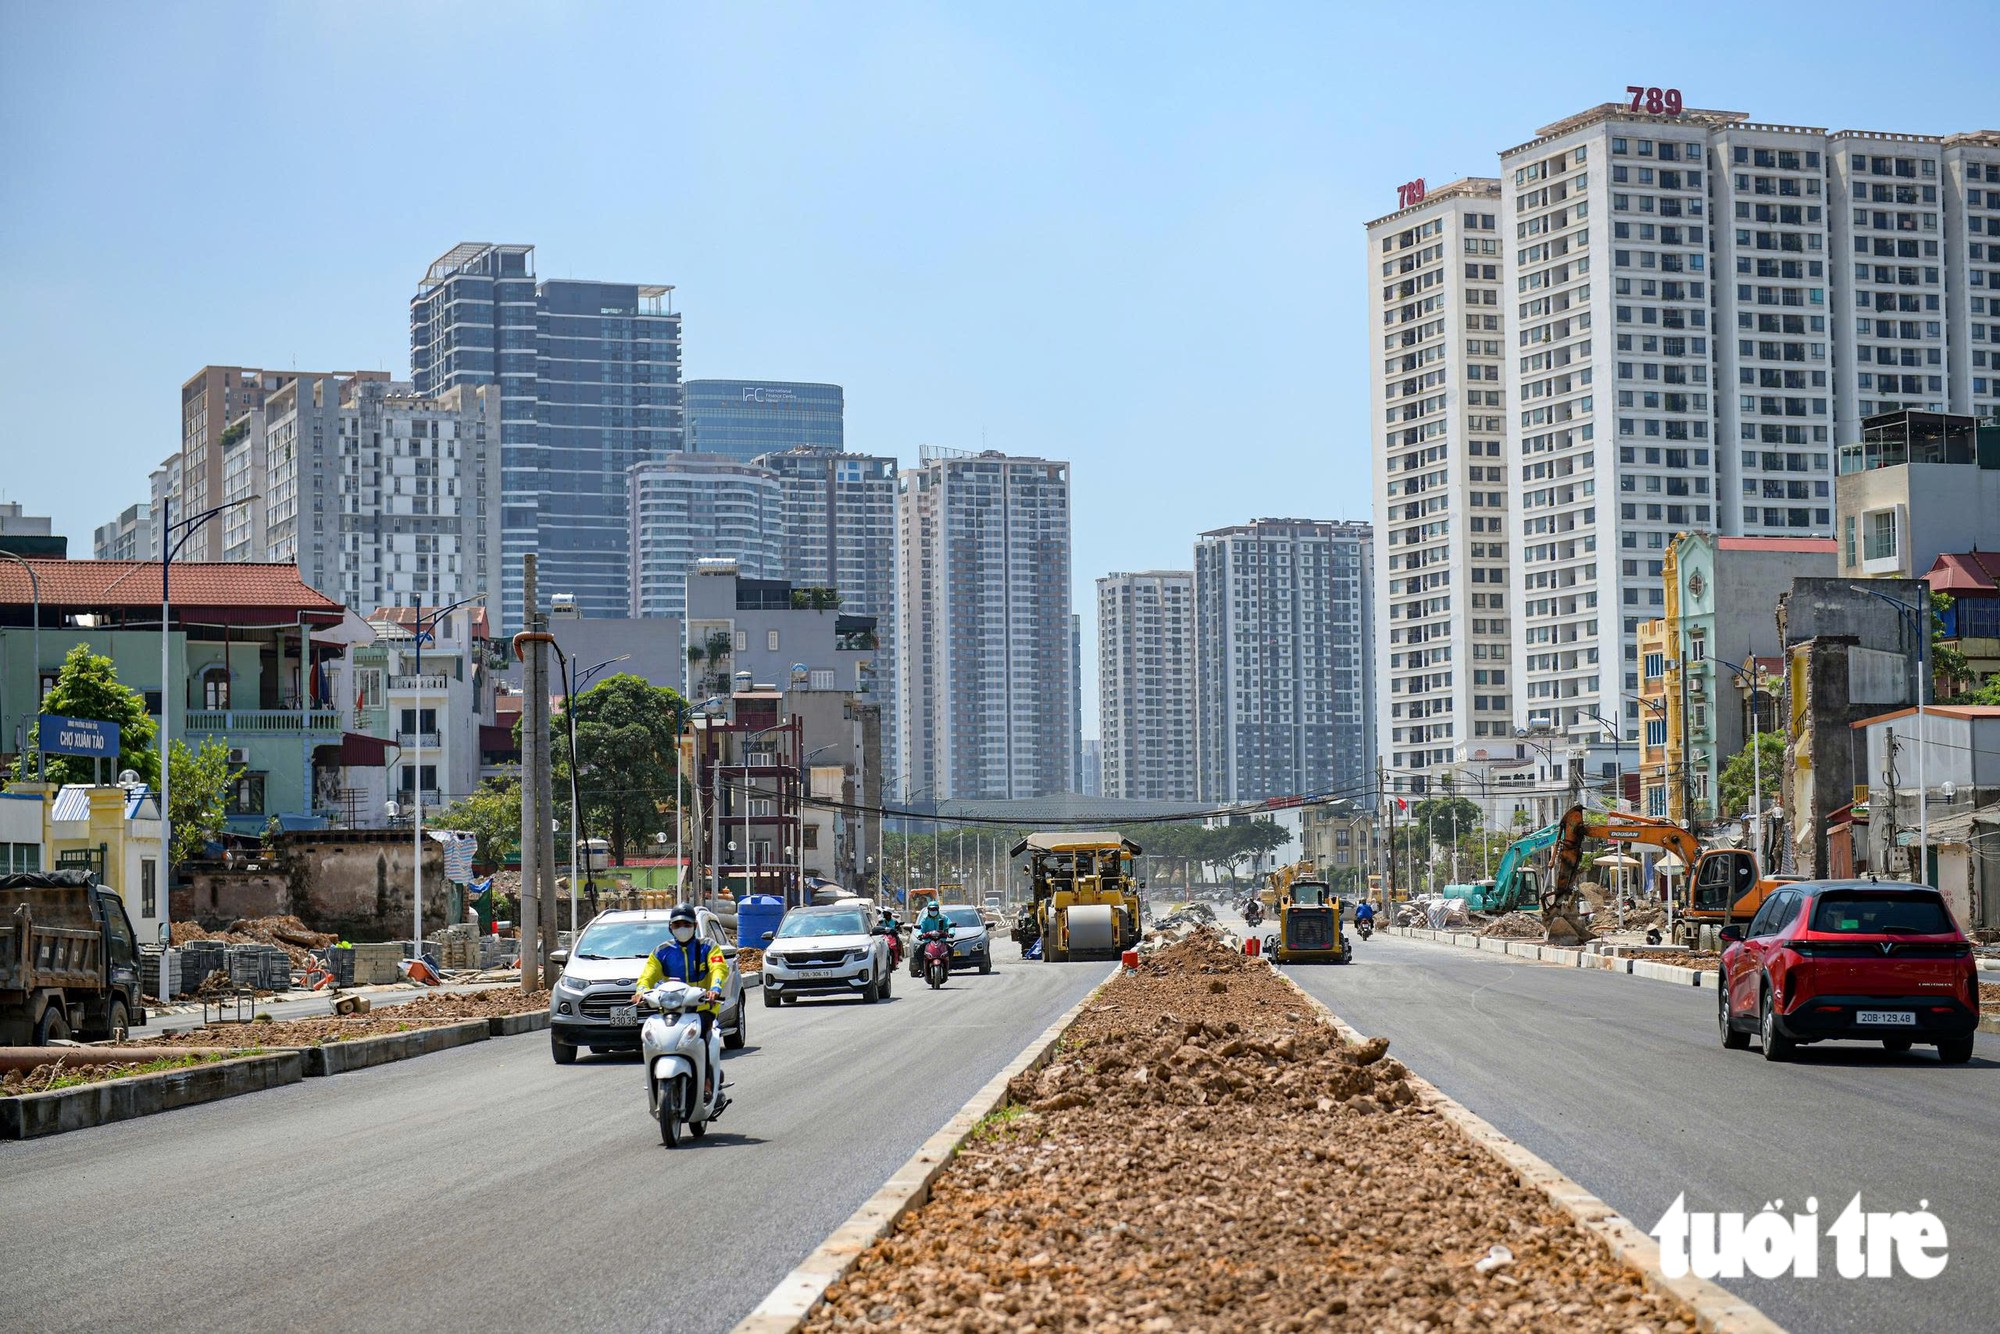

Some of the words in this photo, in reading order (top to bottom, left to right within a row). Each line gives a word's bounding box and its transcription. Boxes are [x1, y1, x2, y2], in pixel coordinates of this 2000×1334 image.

[1626, 86, 1683, 115] 789
[1397, 178, 1425, 210] 789
[60, 731, 74, 750] CHỢ
[74, 731, 91, 749] XUÂN
[92, 730, 104, 750] TẢO
[1861, 1013, 1911, 1023] 20B-129.48
